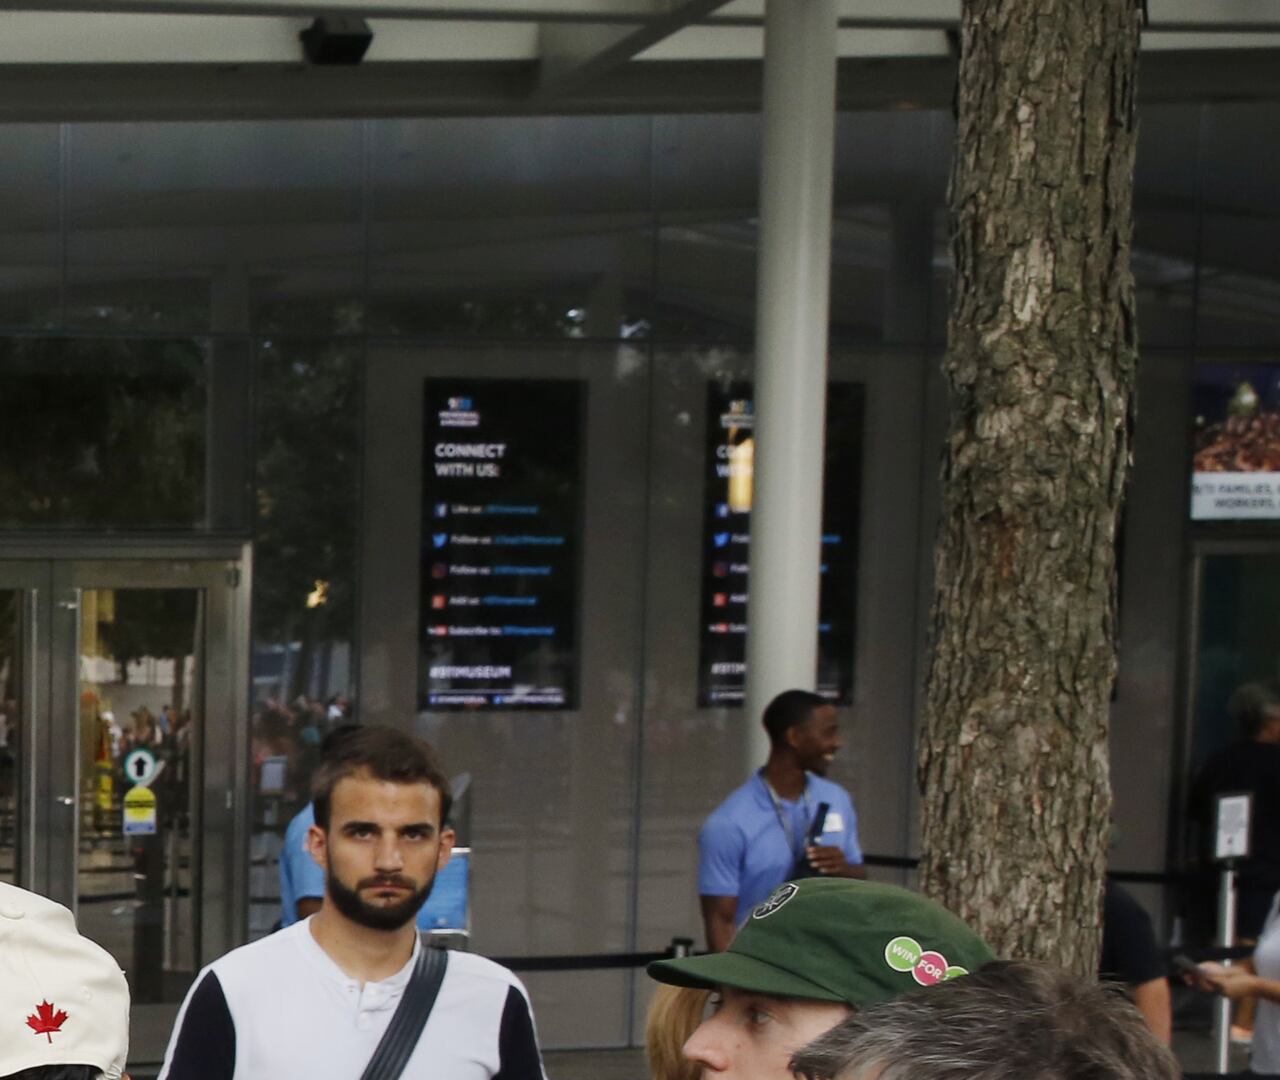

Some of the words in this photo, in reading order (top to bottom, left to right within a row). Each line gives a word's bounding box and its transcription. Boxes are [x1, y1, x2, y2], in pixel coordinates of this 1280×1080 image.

[435, 442, 507, 459] CONNECT
[434, 463, 474, 477] WITH
[892, 944, 918, 964] WIN
[917, 959, 943, 980] FOR
